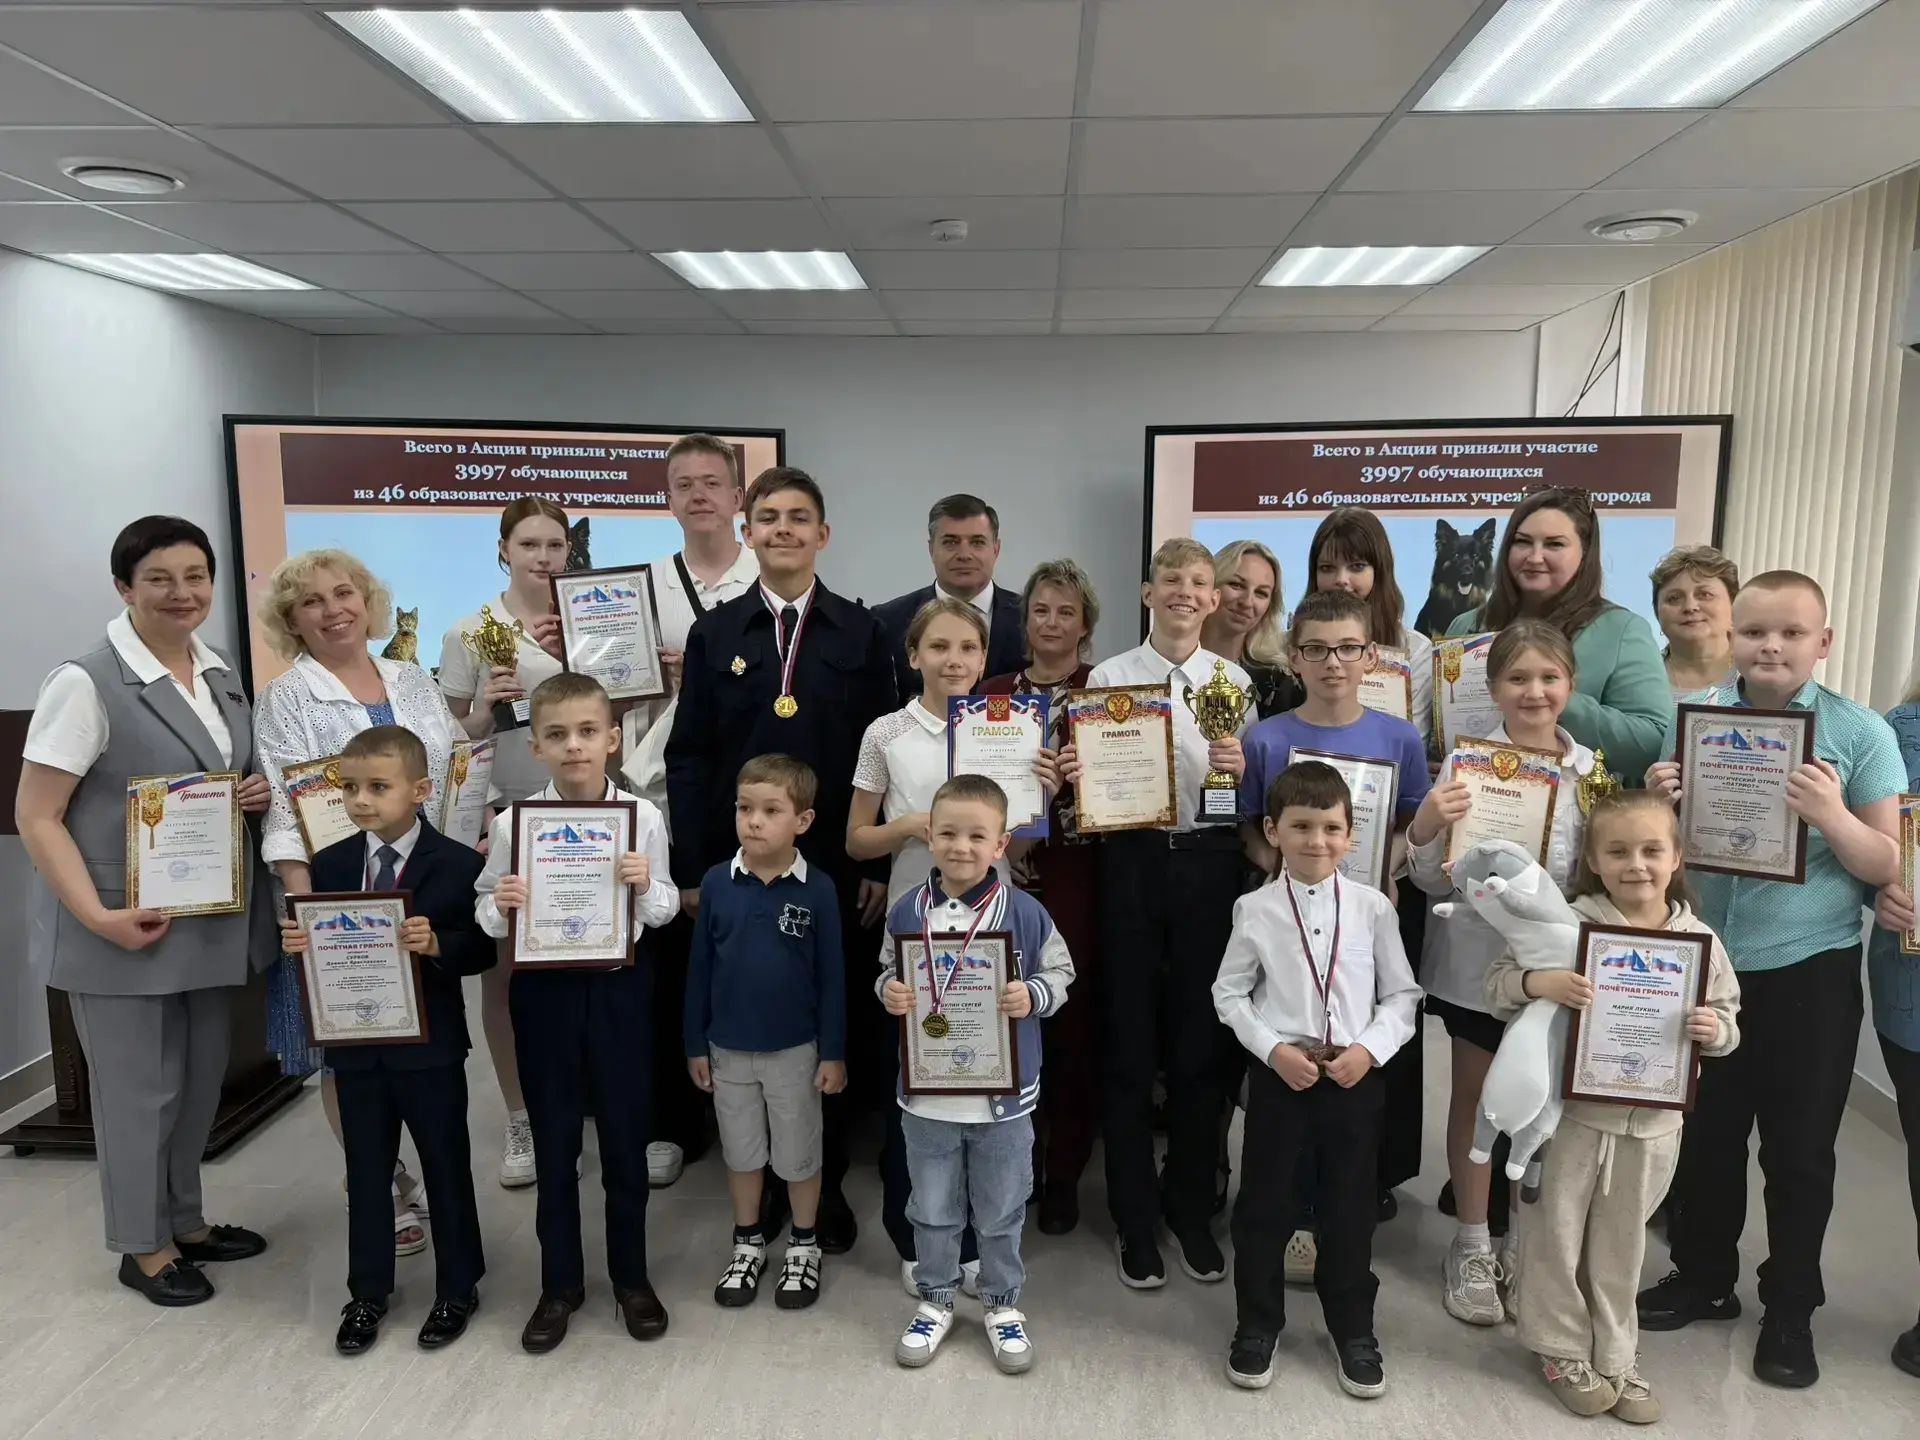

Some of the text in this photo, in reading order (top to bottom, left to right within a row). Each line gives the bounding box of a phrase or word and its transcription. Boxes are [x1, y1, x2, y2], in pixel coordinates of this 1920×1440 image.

[404, 440, 452, 453] Всего
[457, 444, 466, 453] в
[470, 442, 527, 456] Акции
[531, 446, 605, 458] приняли
[1312, 443, 1598, 457] Всего в Акции приняли участие
[455, 464, 628, 481] 3997 обучающихся
[1360, 465, 1543, 483] 3997 обучающихся
[353, 488, 374, 499] из
[378, 483, 405, 503] 46
[563, 491, 667, 504] учреждений
[1259, 494, 1278, 505] из
[1281, 488, 1308, 508] 46
[1312, 491, 1466, 507] образовательных
[1591, 492, 1651, 505] города
[1359, 680, 1384, 688] АМОТА
[972, 726, 1023, 736] ГРАМОТА
[1101, 729, 1141, 739] ГРАМОТА
[1700, 762, 1784, 774] ПОЧЁТНАЯ ГРАМОТА
[178, 790, 226, 802] Грамота
[1481, 785, 1522, 799] ГРАМОТА
[1599, 984, 1679, 997] ПОЧЁТНАЯ ГРАМОТА
